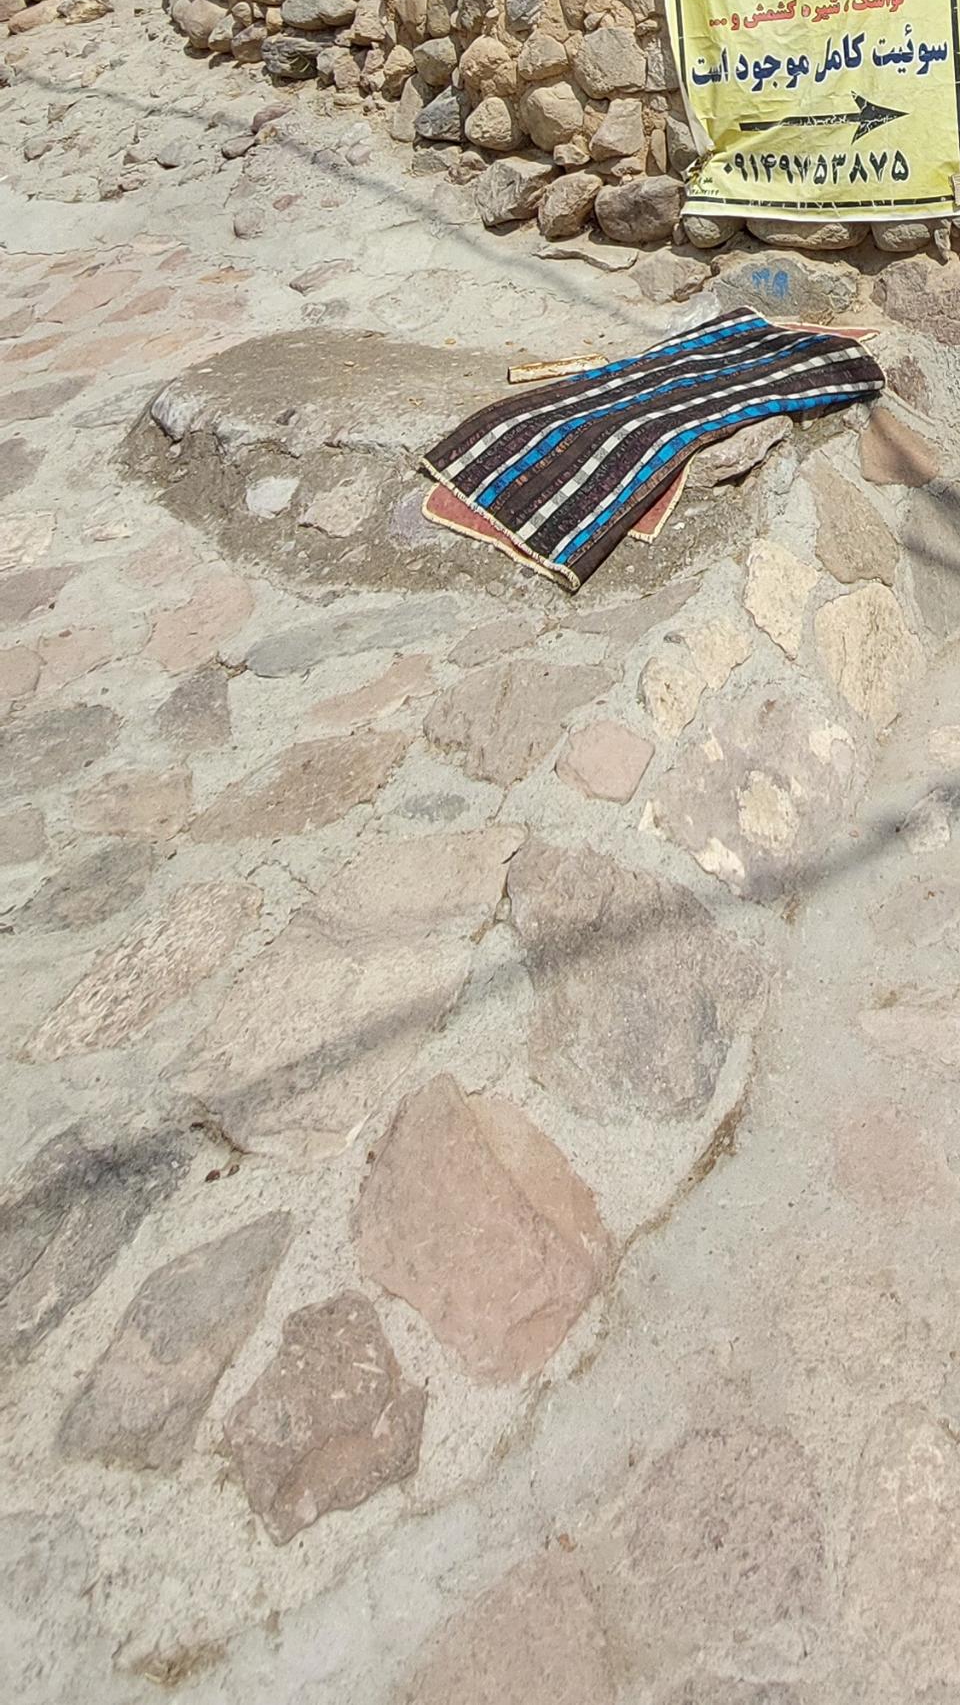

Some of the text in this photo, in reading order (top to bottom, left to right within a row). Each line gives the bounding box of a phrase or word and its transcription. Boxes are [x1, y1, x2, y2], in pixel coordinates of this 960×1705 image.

[730, 14, 741, 30] و
[743, 0, 797, 29] کشمش
[691, 23, 949, 92] سوئیت کامل موجود است
[723, 149, 910, 185] ۰۹۱۴۹۷۵۳۸۷۵
